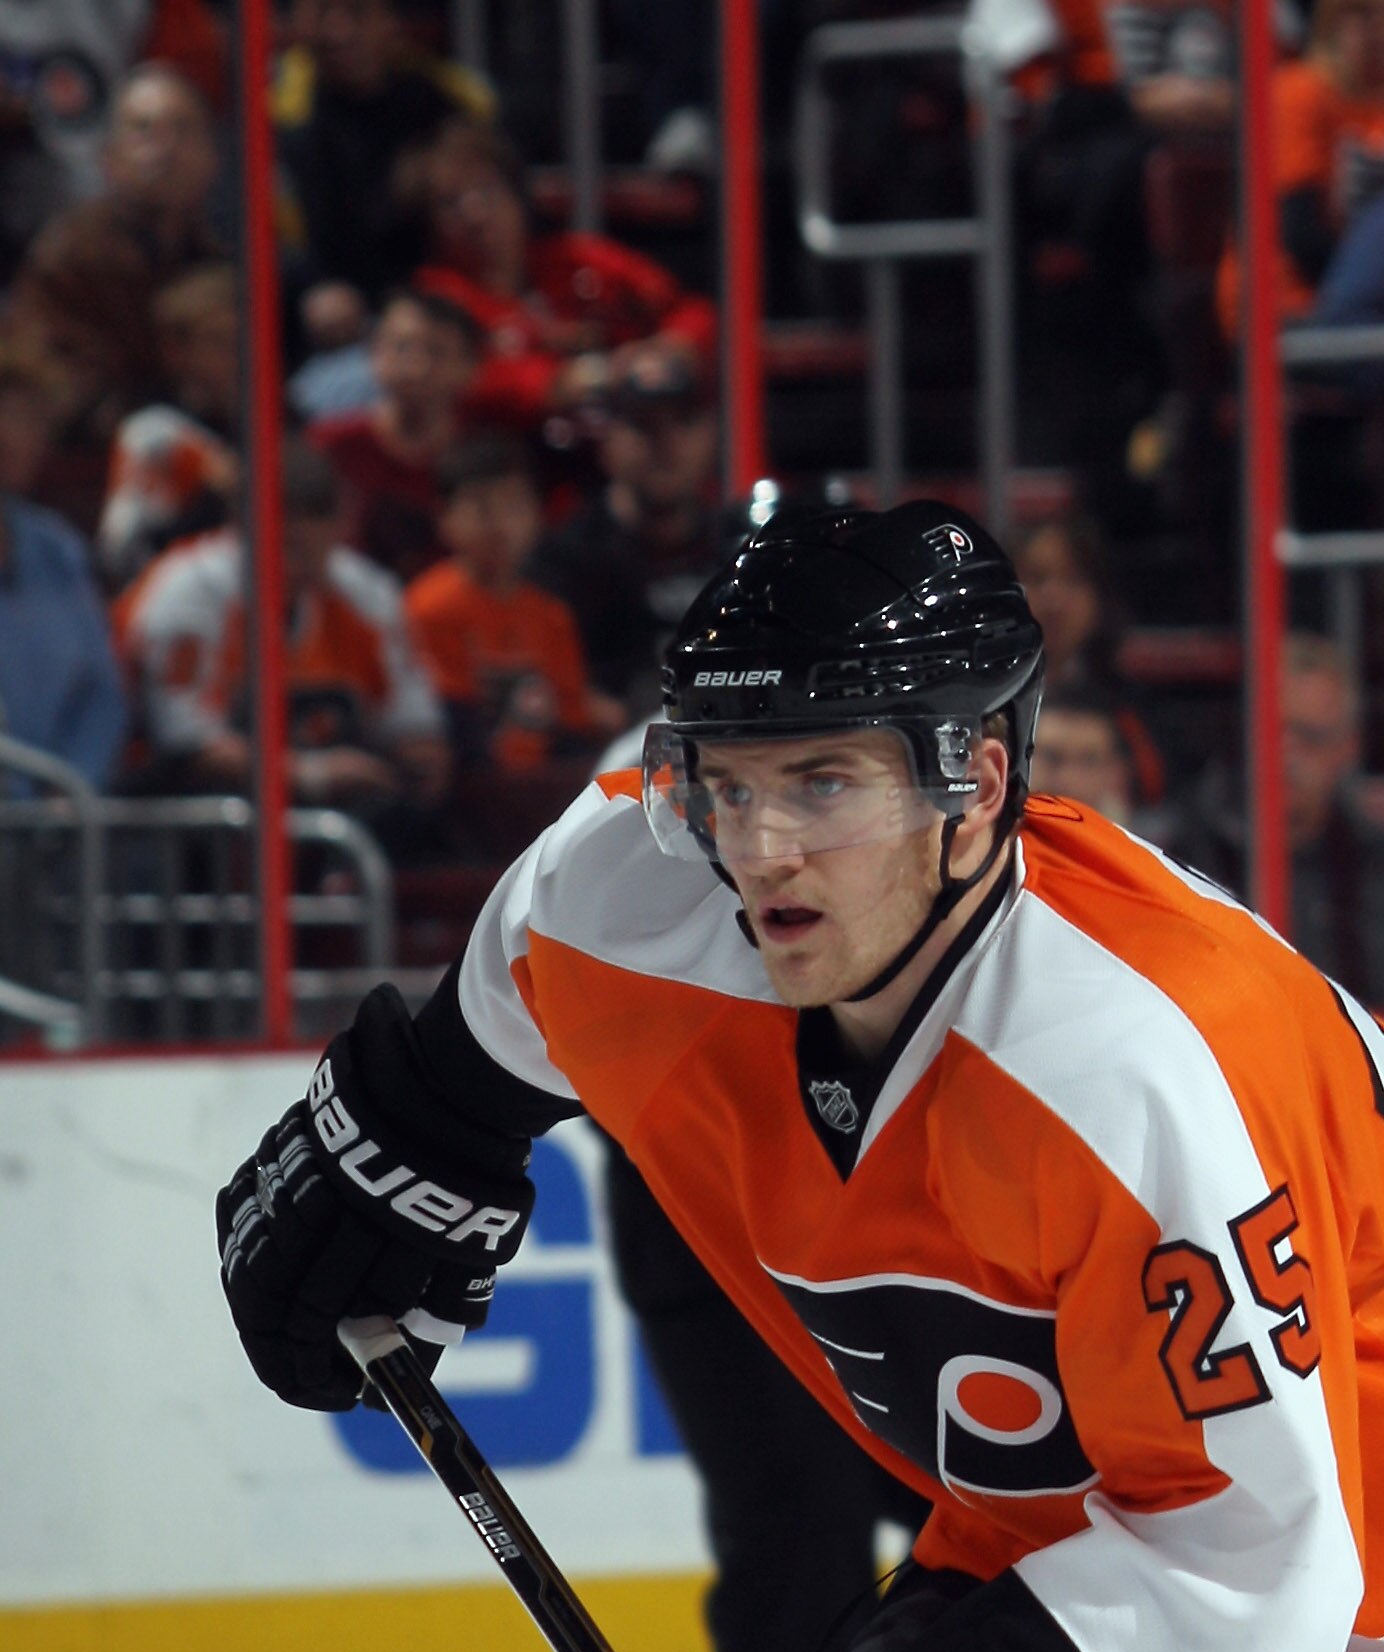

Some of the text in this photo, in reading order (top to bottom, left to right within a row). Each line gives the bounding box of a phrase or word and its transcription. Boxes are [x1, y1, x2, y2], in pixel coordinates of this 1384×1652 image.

[693, 669, 783, 687] BAUER
[309, 1058, 520, 1251] BAUER
[1141, 1182, 1321, 1422] 25
[458, 1492, 521, 1562] BAUER
